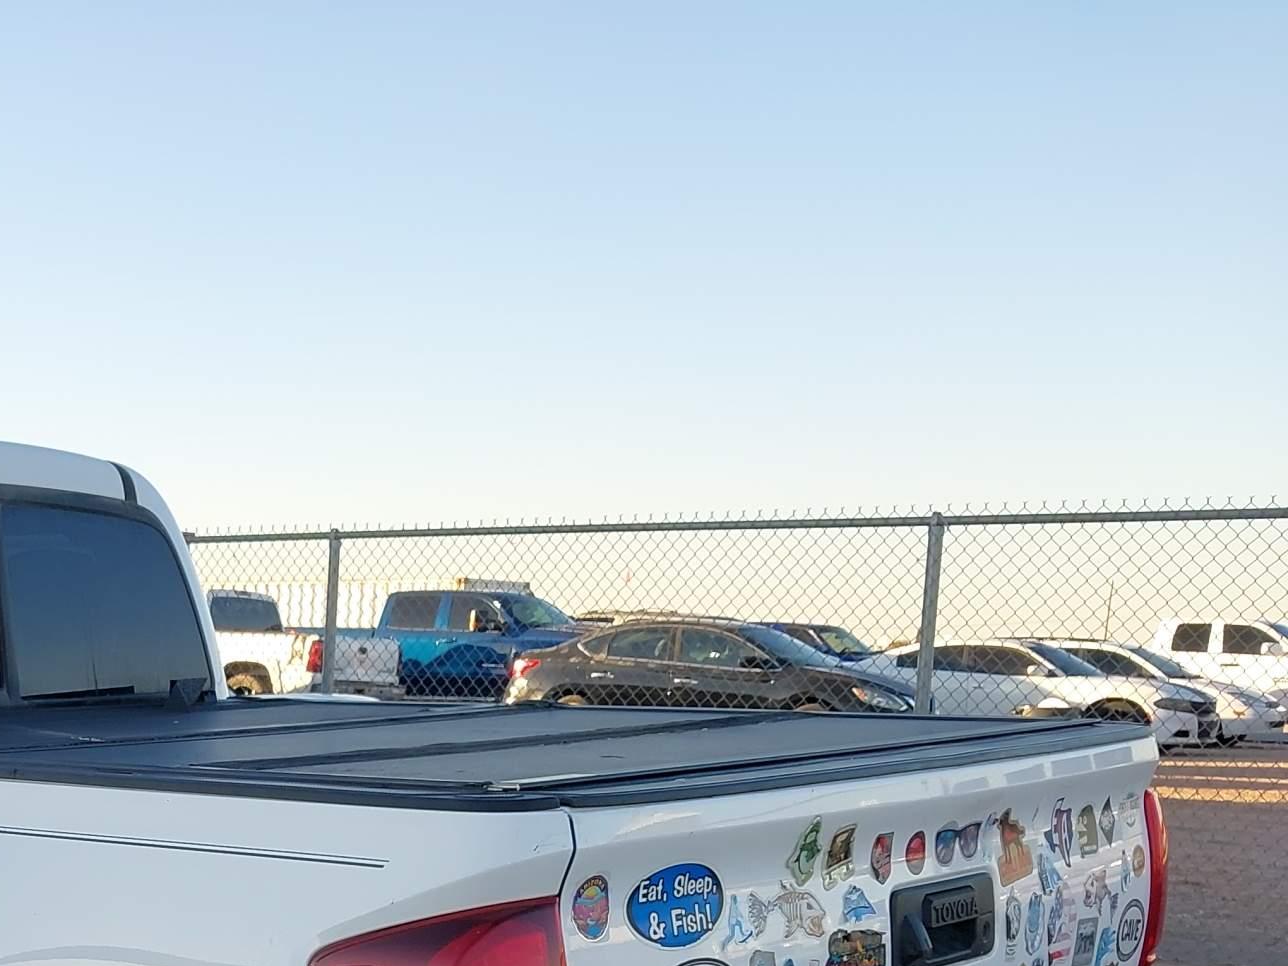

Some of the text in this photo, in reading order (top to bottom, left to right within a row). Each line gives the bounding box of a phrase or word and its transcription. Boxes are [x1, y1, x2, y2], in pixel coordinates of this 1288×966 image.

[638, 872, 717, 904] Eat, Sleep,
[649, 903, 713, 940] & Fish!
[934, 897, 979, 924] TOYOTA
[1120, 918, 1142, 942] CAVE
